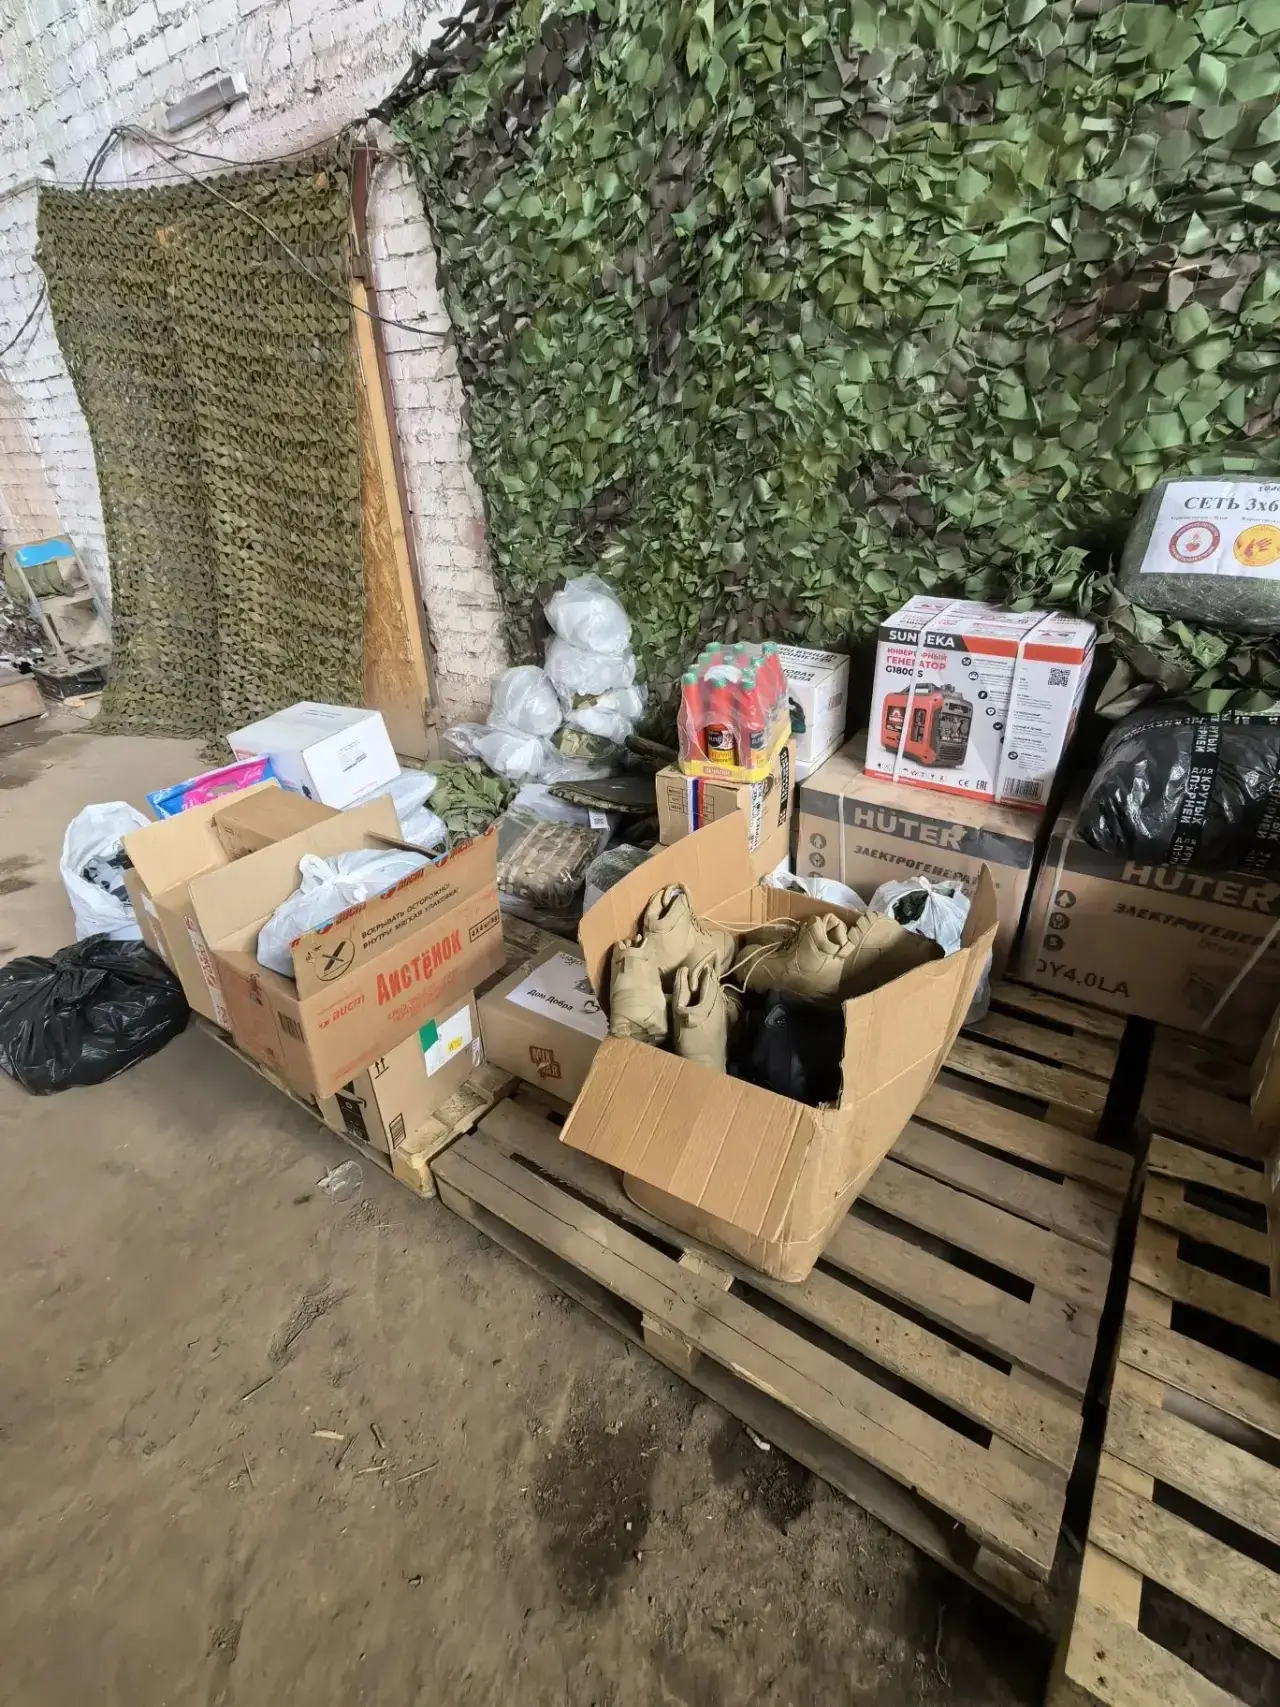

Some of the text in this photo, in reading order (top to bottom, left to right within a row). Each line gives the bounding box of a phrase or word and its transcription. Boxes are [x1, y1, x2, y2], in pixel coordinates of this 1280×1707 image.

[1184, 497, 1240, 510] СЕТЬ
[1191, 776, 1213, 826] КРУТЫХ
[854, 807, 968, 851] HÜTER
[362, 911, 405, 939] ВСКРЫВАТЬ
[363, 927, 393, 950] ВНУТРИ
[394, 909, 423, 931] МЯГКАЯ
[527, 988, 574, 1012] Дом Добра
